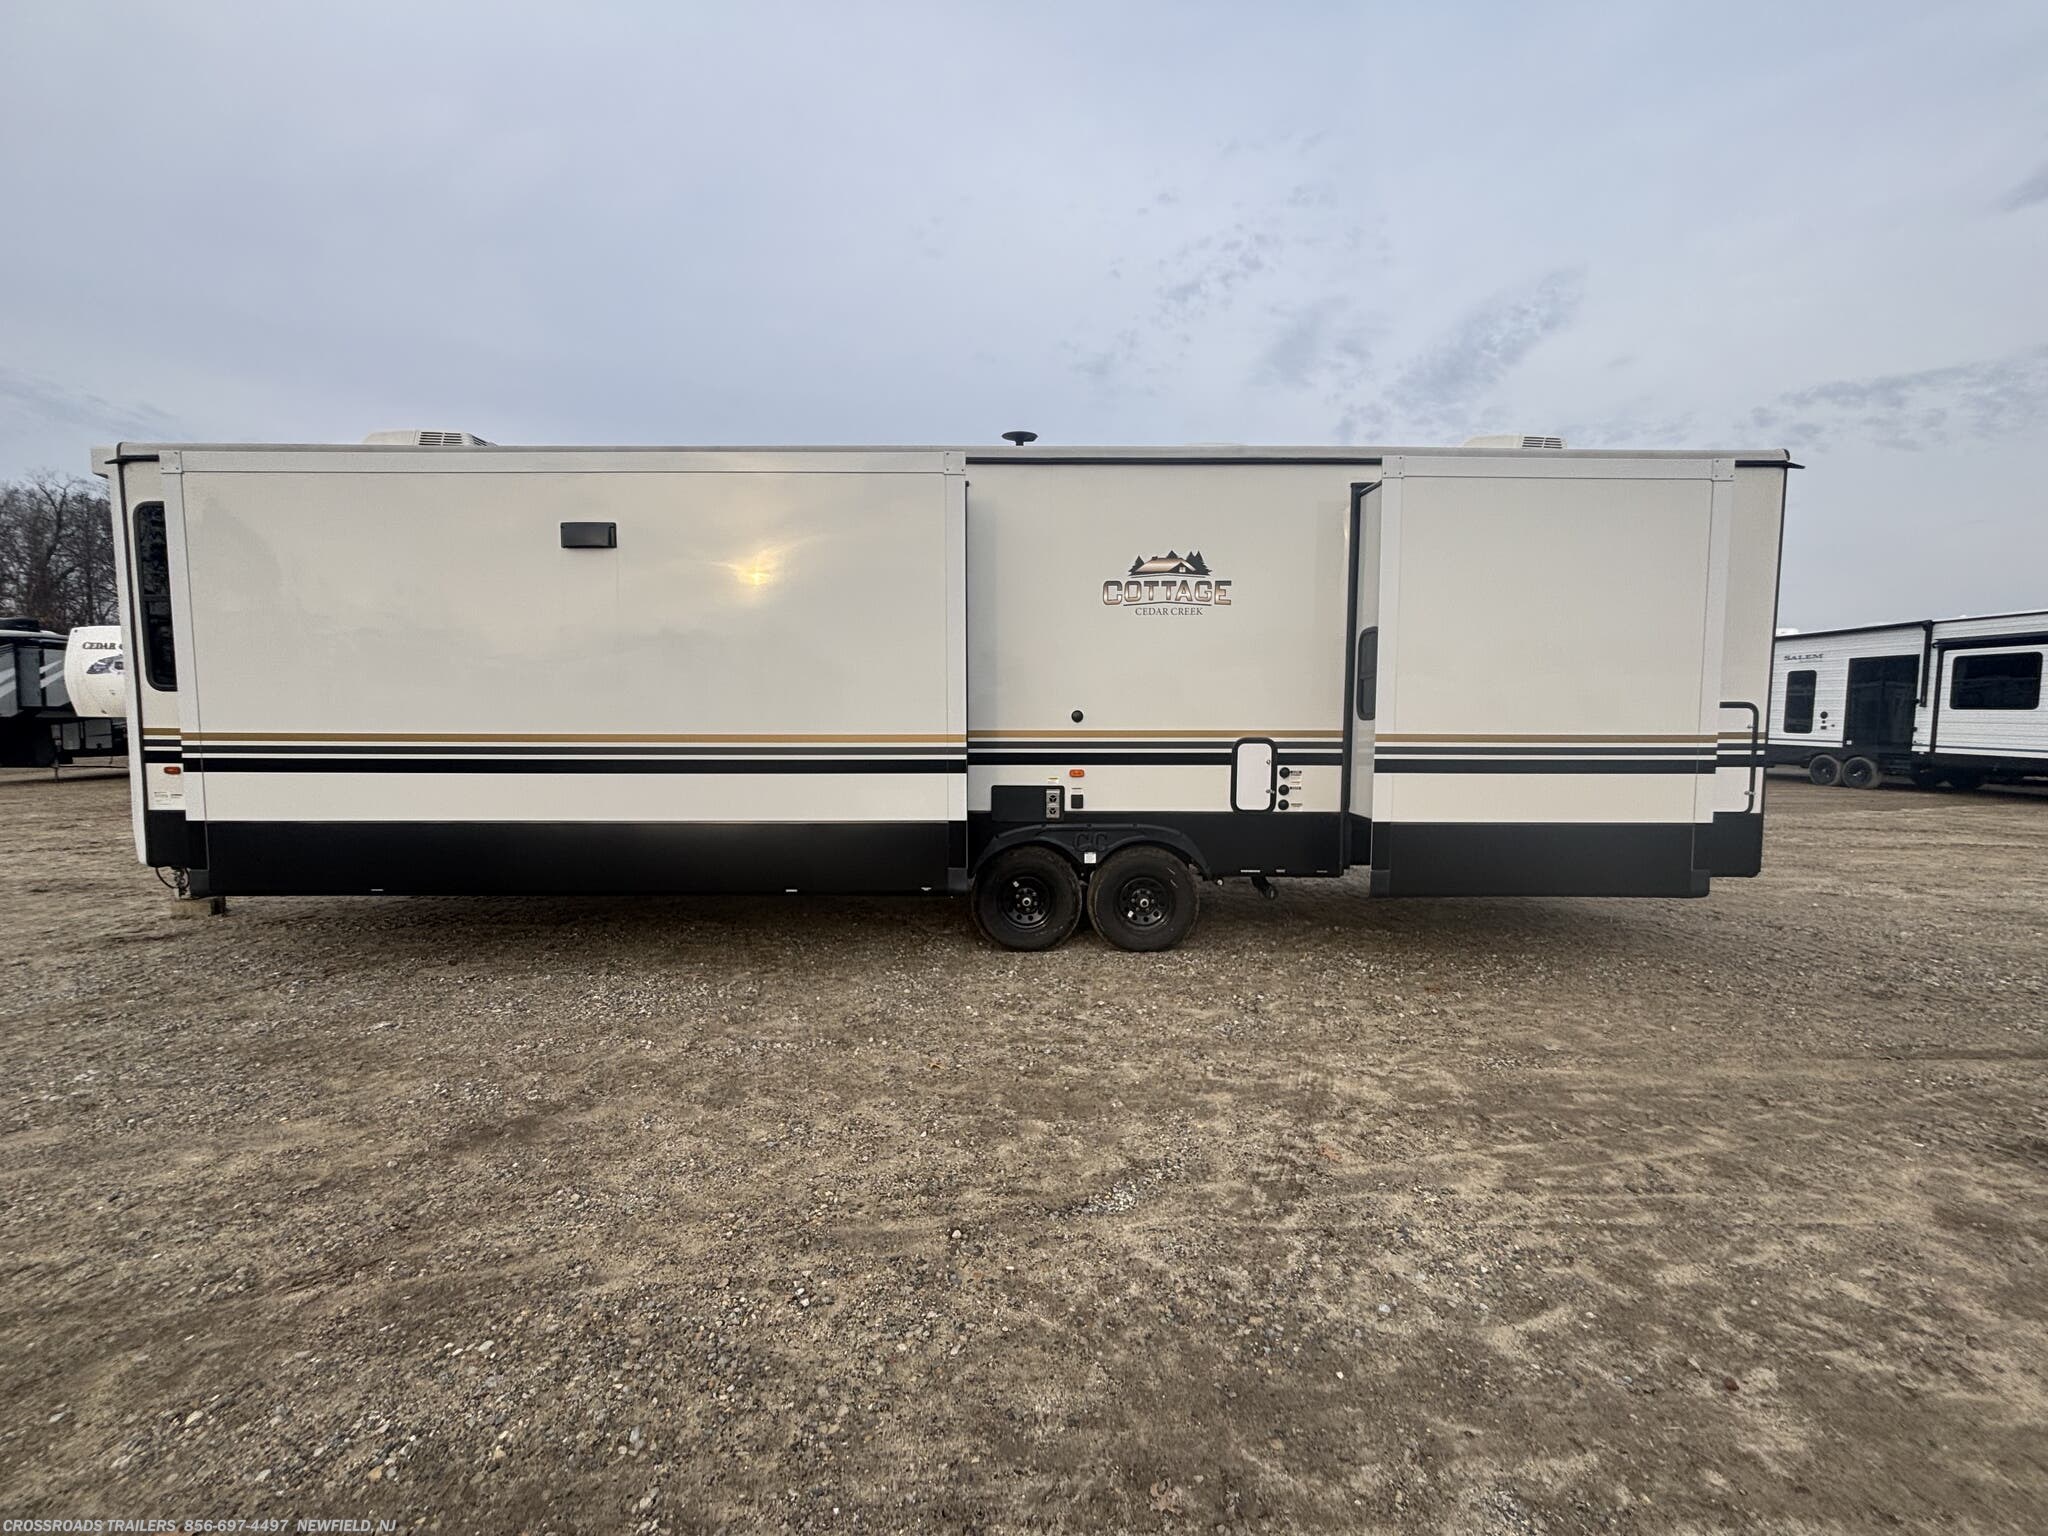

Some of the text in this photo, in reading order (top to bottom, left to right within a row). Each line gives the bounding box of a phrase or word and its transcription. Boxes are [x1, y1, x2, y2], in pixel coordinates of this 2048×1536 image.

[1103, 580, 1232, 606] COTTAGE
[1135, 607, 1204, 616] CEDAR CREEK
[82, 642, 116, 650] CEDAR
[1783, 653, 1824, 661] SALEM
